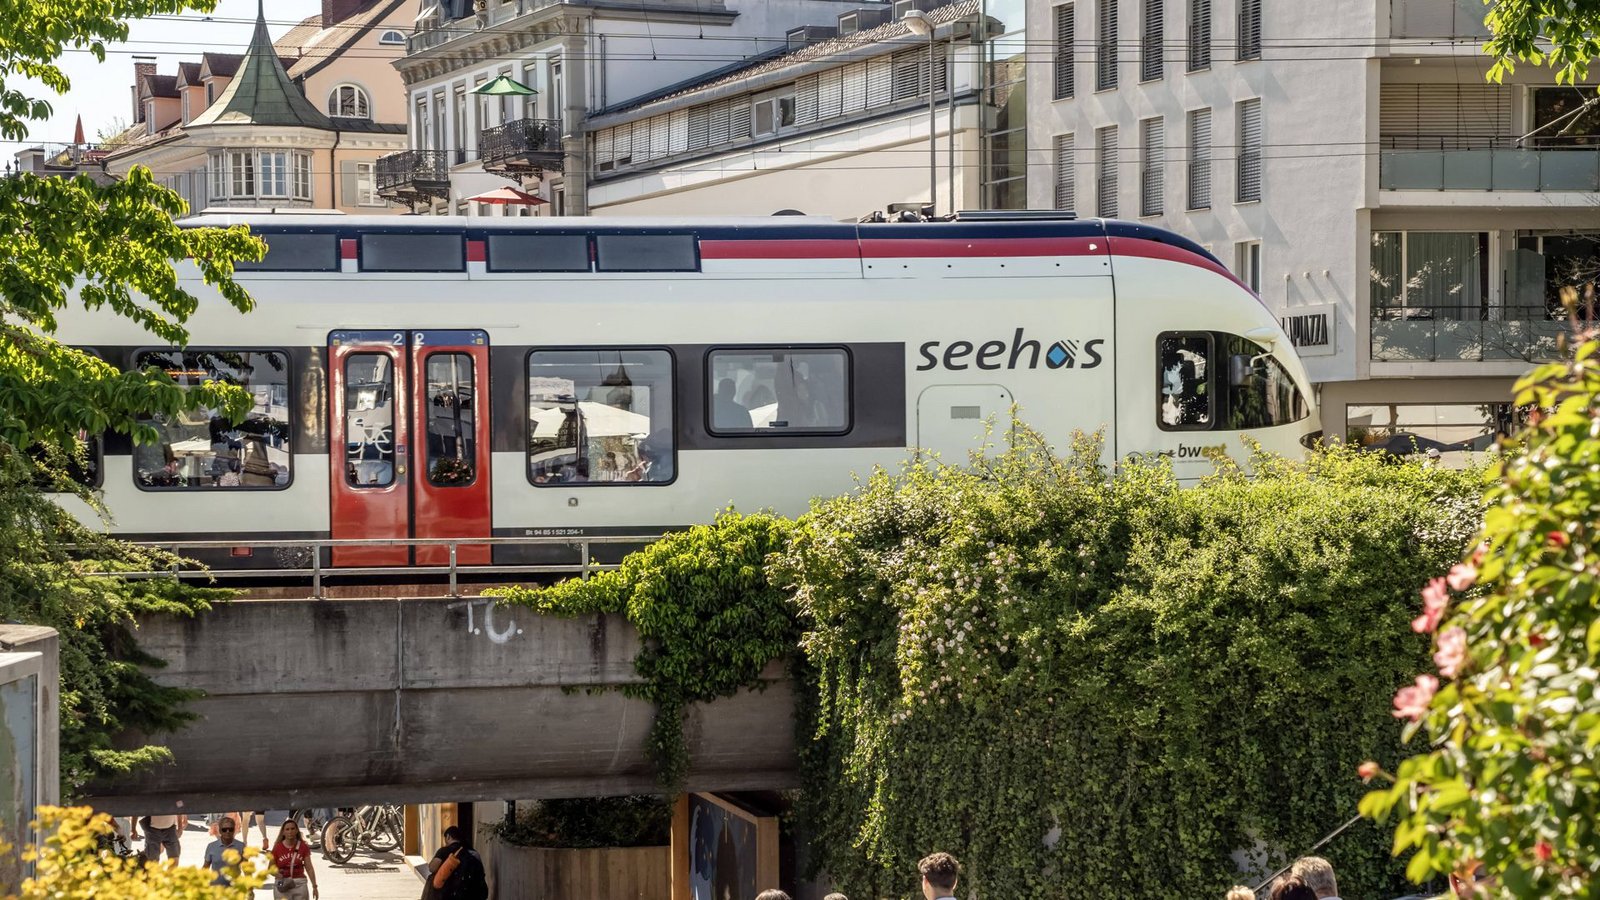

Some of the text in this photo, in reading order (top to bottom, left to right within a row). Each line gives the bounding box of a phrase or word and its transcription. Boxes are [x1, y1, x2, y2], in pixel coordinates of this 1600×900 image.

[393, 333, 403, 346] 2
[414, 333, 425, 345] 2
[916, 327, 1104, 371] seehas
